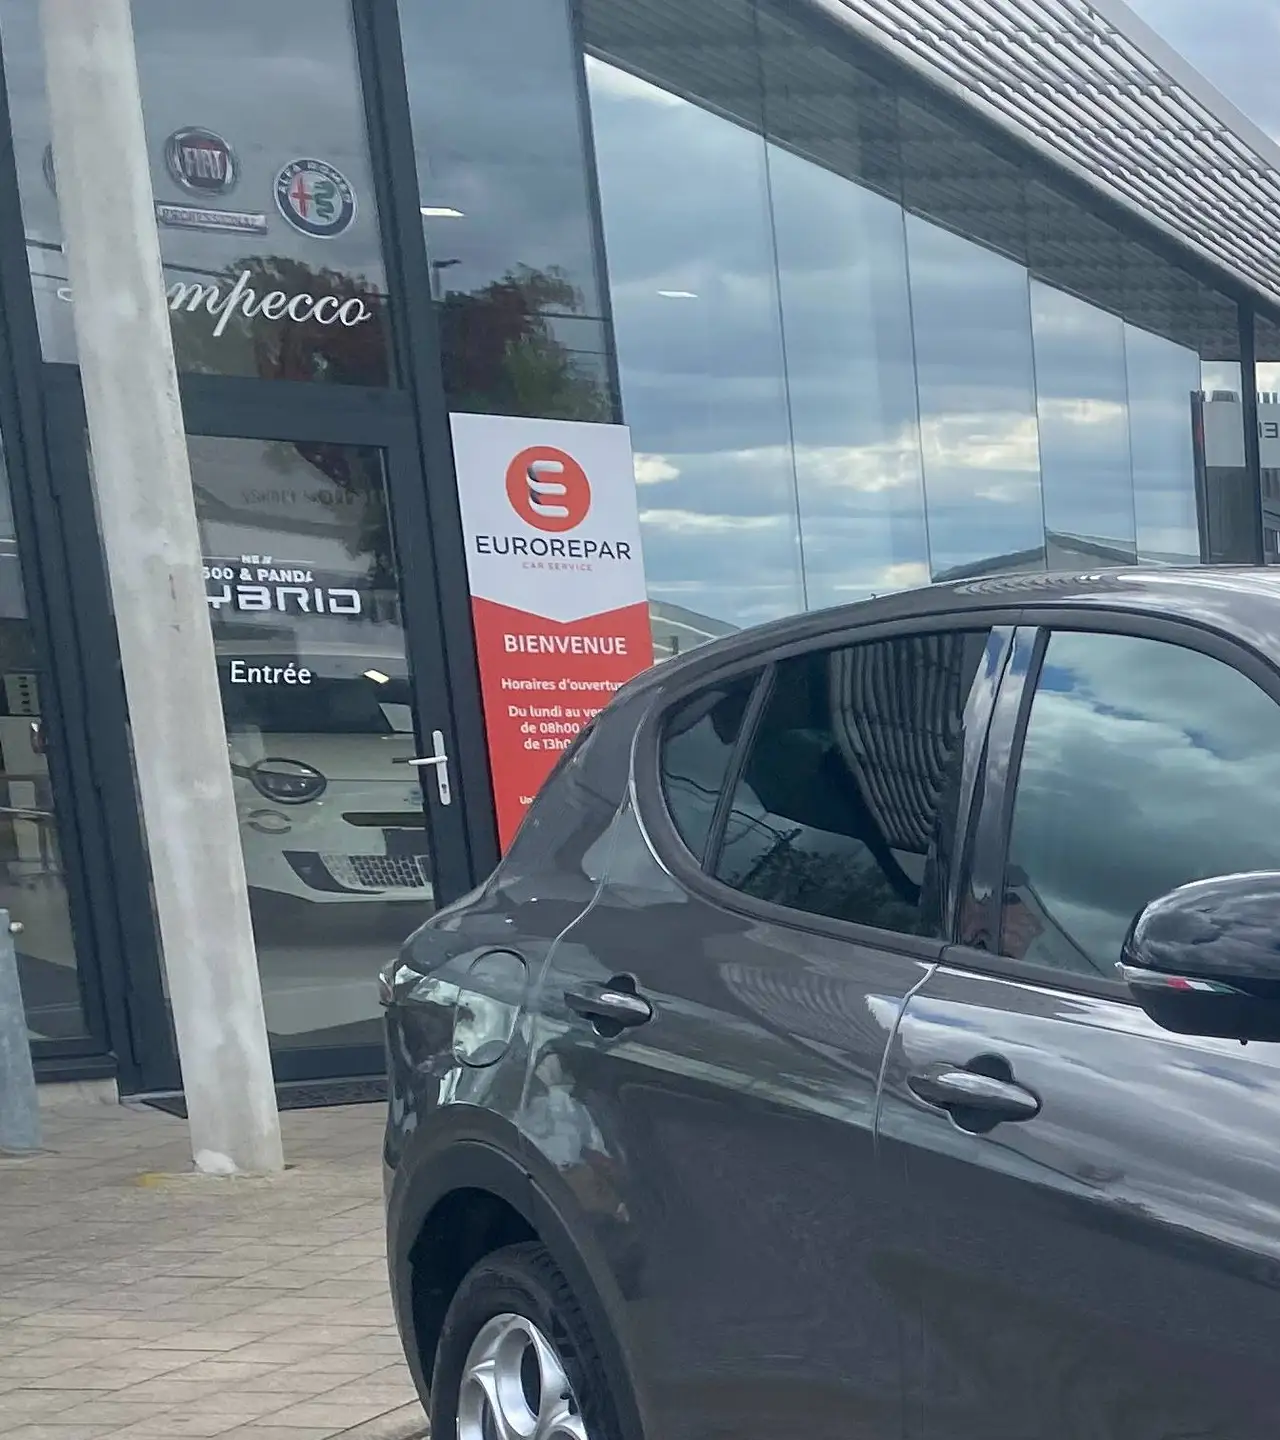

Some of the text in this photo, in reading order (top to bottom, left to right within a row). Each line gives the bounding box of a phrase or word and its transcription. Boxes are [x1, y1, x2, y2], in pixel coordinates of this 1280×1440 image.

[182, 147, 226, 180] FIAT
[57, 270, 372, 337] mpecco
[475, 535, 632, 560] EUROREPAR
[240, 567, 253, 581] &
[257, 568, 314, 583] PANDA
[522, 562, 593, 572] CAR SERVICE
[503, 634, 628, 655] BIENVENUE
[230, 660, 311, 684] Entrée
[501, 677, 625, 692] Horaires d'ouvertur
[508, 705, 527, 717] Du
[530, 704, 561, 717] lundi
[565, 708, 581, 718] au
[520, 722, 580, 734] de 08h00
[523, 737, 572, 750] de 13h0
